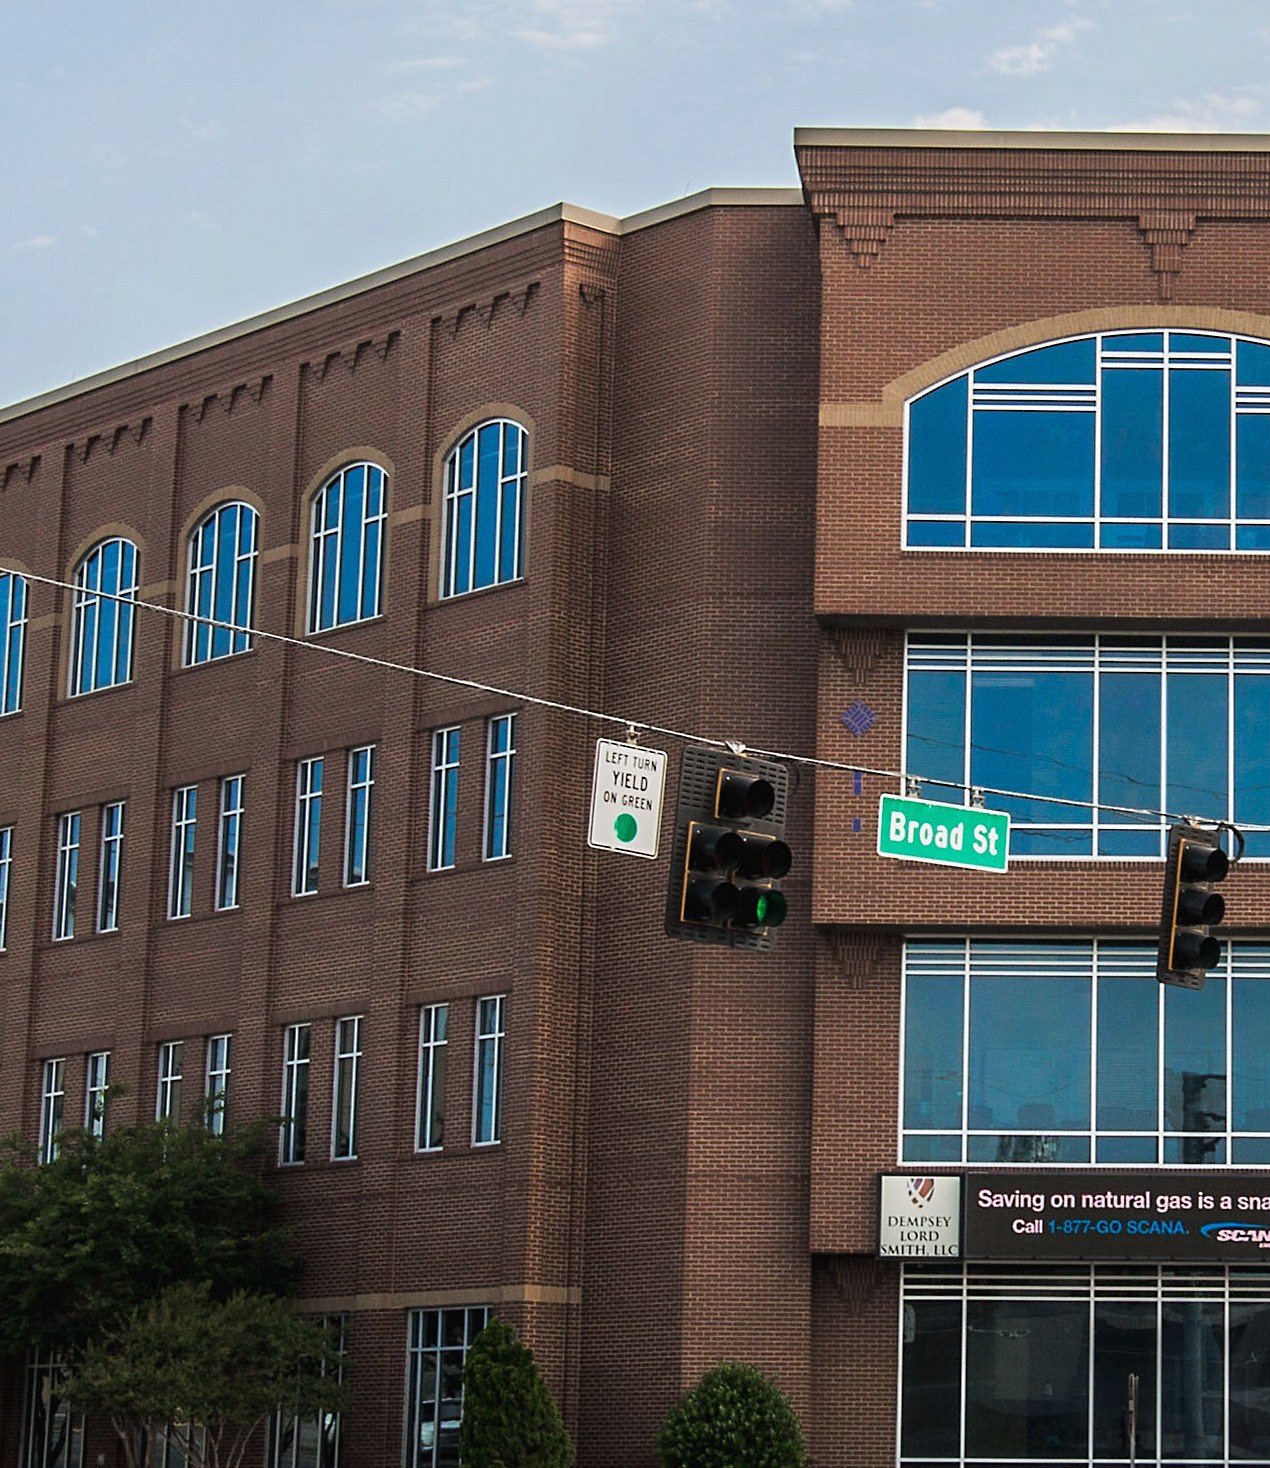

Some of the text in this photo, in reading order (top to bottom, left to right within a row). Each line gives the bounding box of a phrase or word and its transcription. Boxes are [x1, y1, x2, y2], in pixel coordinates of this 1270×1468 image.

[605, 750, 658, 772] LEFT TURN
[612, 770, 648, 791] YIELD
[603, 790, 652, 811] ON GREEN
[889, 811, 999, 856] Broad St
[978, 1190, 1045, 1212] Saving
[1050, 1194, 1077, 1210] on
[1081, 1190, 1152, 1210] natural
[1156, 1196, 1192, 1214] gas
[1197, 1192, 1216, 1210] is
[1219, 1196, 1233, 1211] a
[888, 1215, 952, 1230] DEMPSEY
[1012, 1219, 1190, 1236] Call 1-877-GO SCANA.
[899, 1230, 940, 1243] LORD
[880, 1244, 958, 1257] SMITH, LLC
